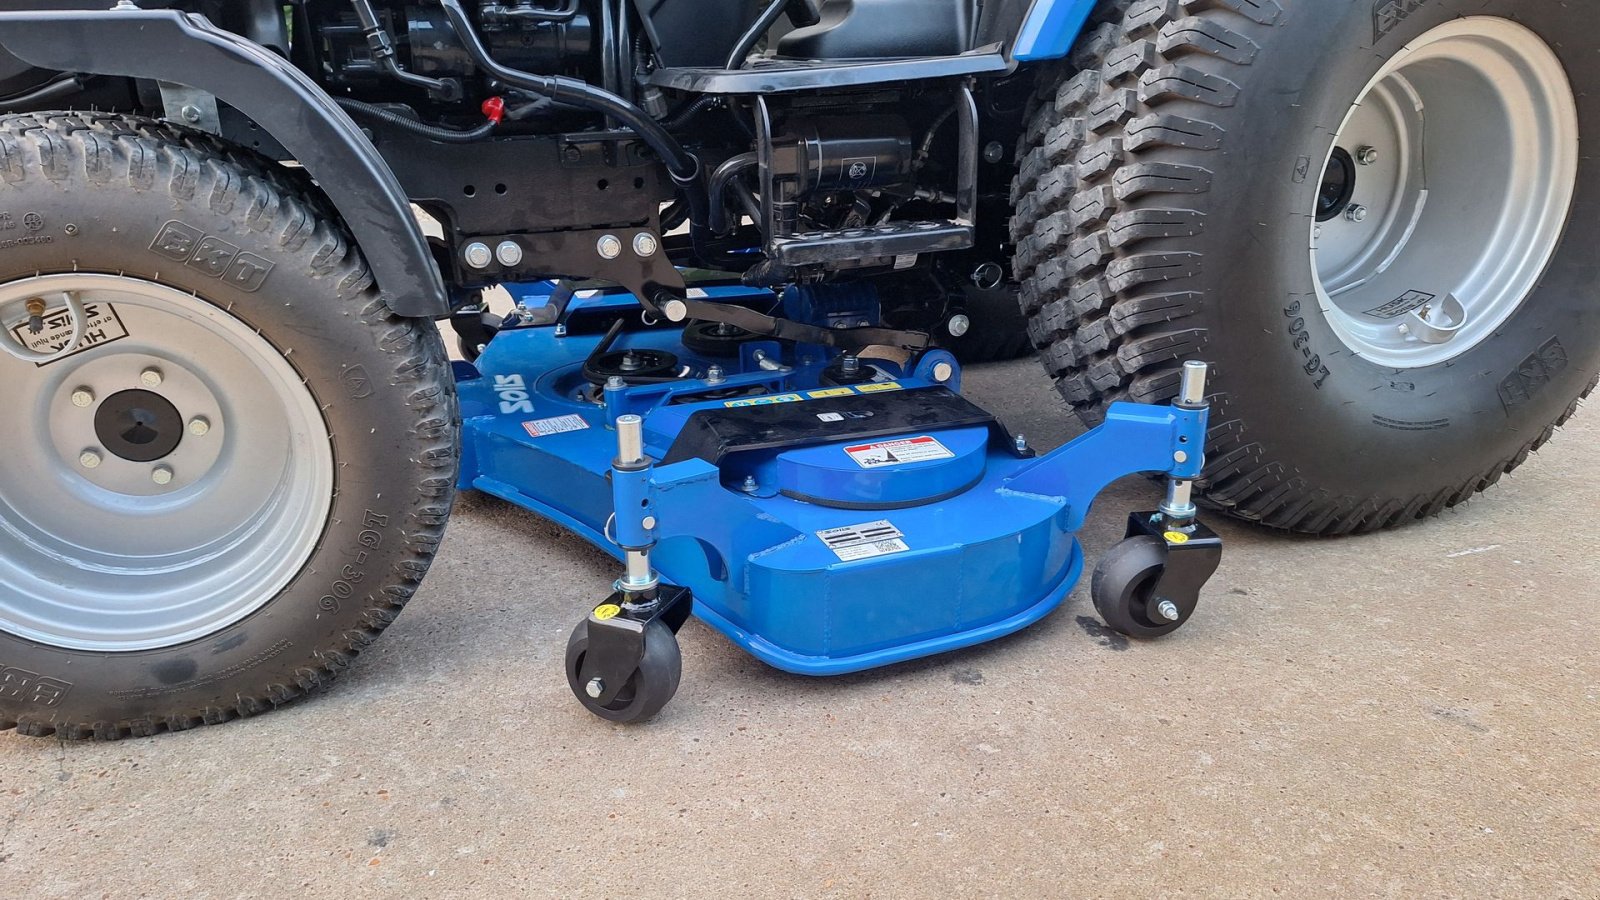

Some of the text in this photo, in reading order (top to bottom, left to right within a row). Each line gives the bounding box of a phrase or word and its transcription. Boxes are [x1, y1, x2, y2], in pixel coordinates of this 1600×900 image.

[155, 225, 268, 283] BKT
[1284, 299, 1331, 390] LG-306
[319, 509, 389, 616] LG-306
